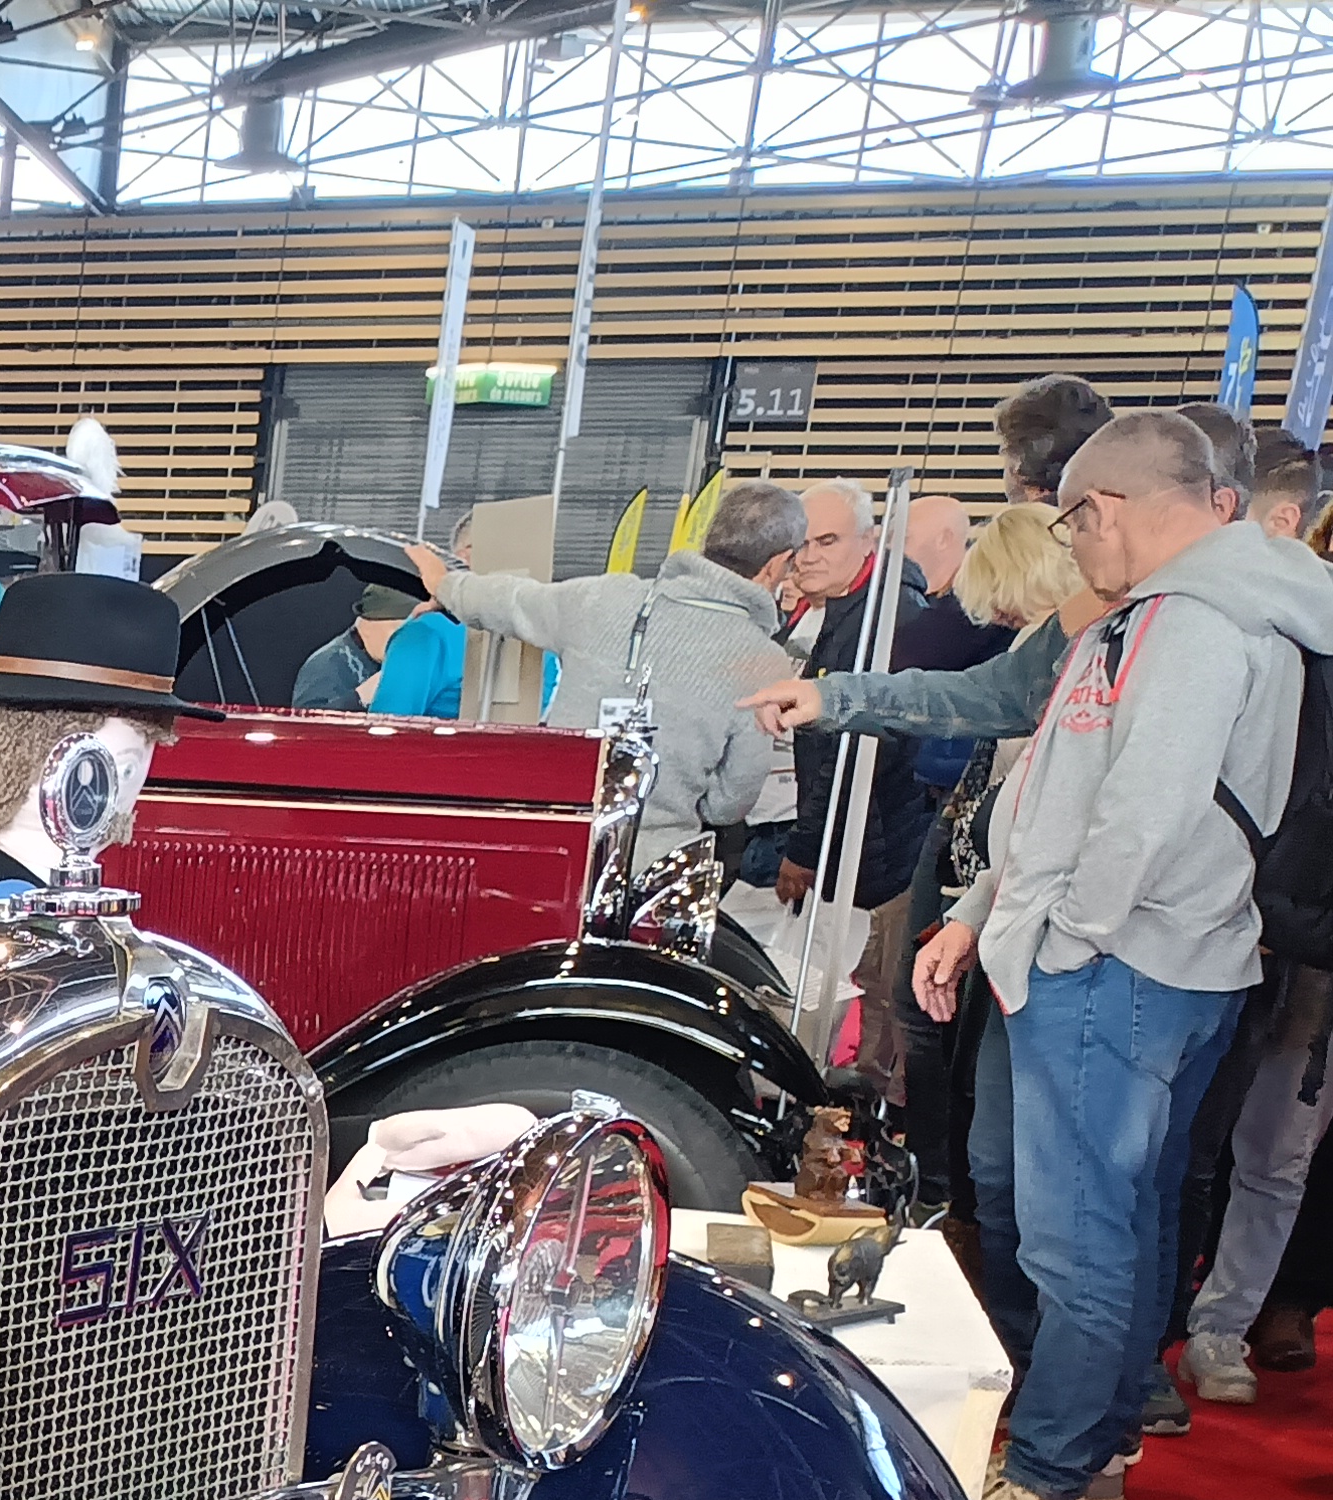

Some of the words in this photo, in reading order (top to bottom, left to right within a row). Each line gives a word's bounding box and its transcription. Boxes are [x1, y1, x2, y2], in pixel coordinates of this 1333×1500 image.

[496, 370, 541, 389] Sortie
[736, 387, 805, 416] 5.11
[54, 1208, 214, 1328] SIX
